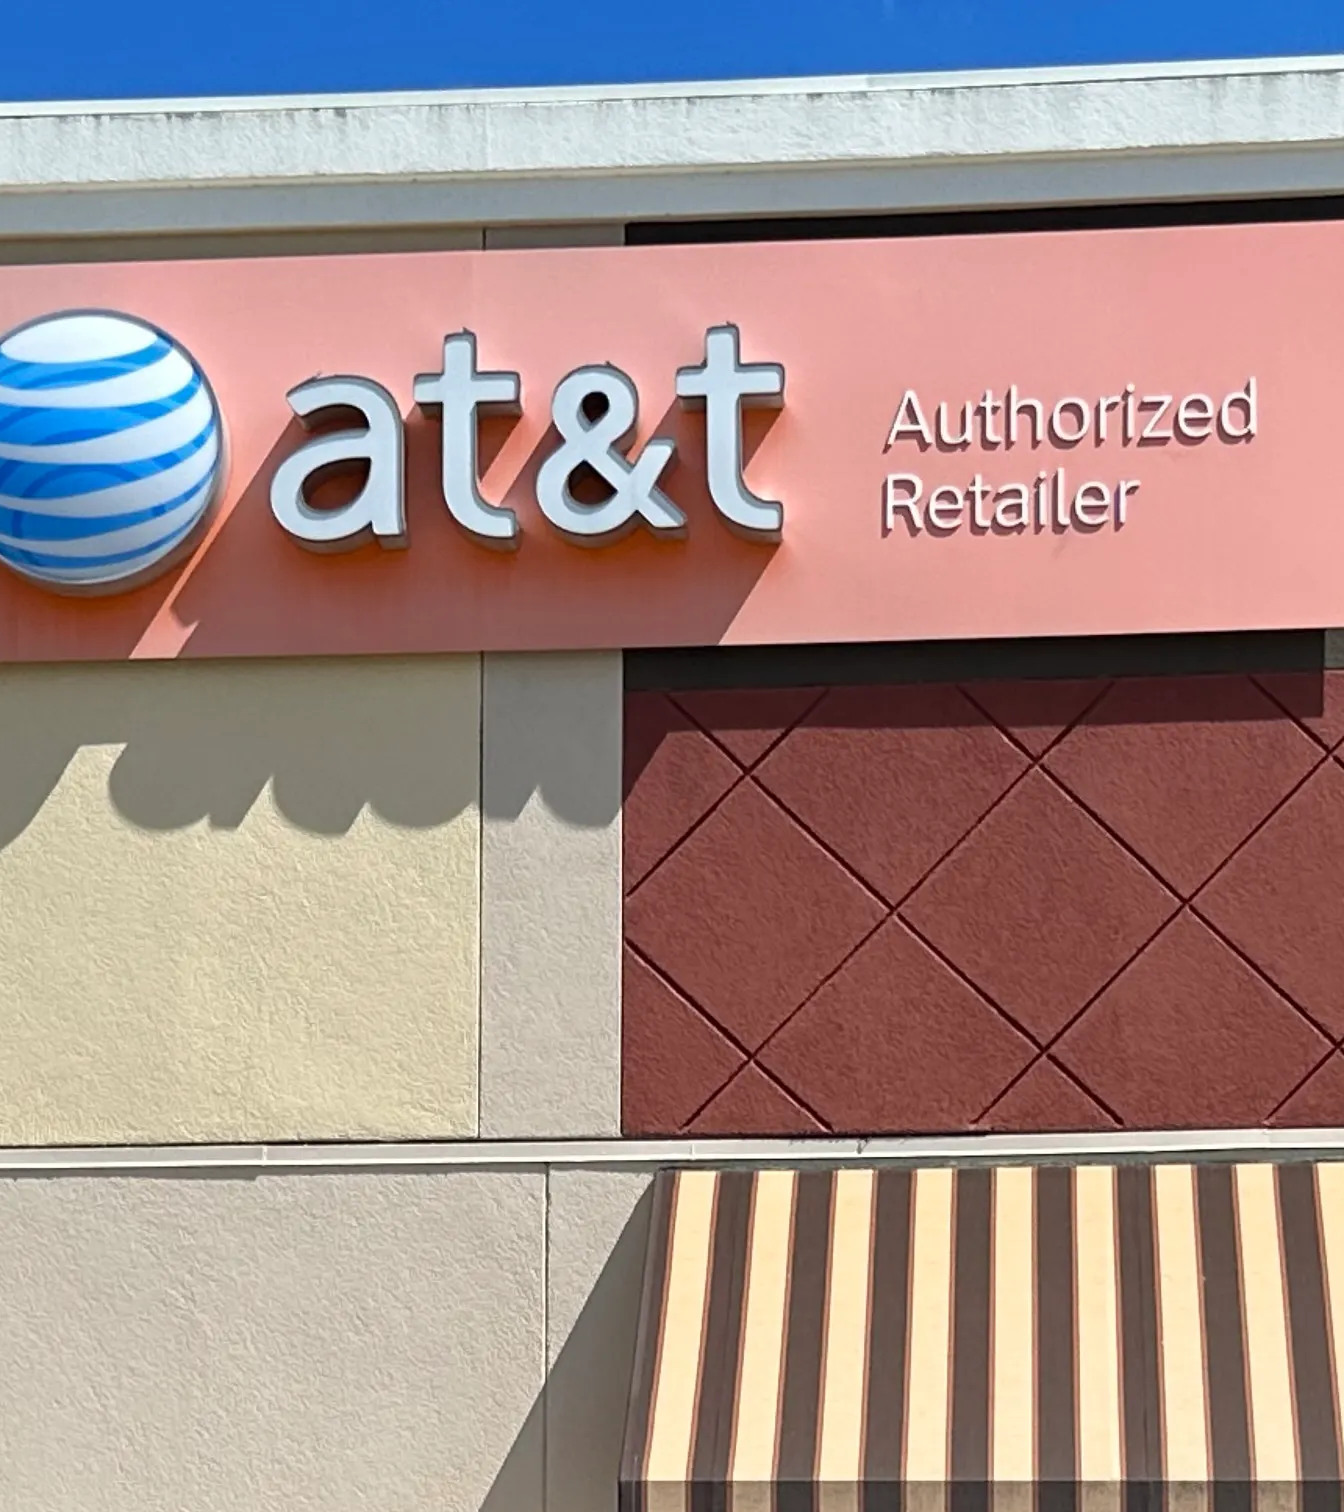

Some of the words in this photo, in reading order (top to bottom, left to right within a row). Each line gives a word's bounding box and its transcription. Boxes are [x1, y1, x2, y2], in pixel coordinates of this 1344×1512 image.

[269, 322, 785, 553] at&t
[884, 375, 1258, 453] Authorized
[881, 467, 1141, 537] Retailer
